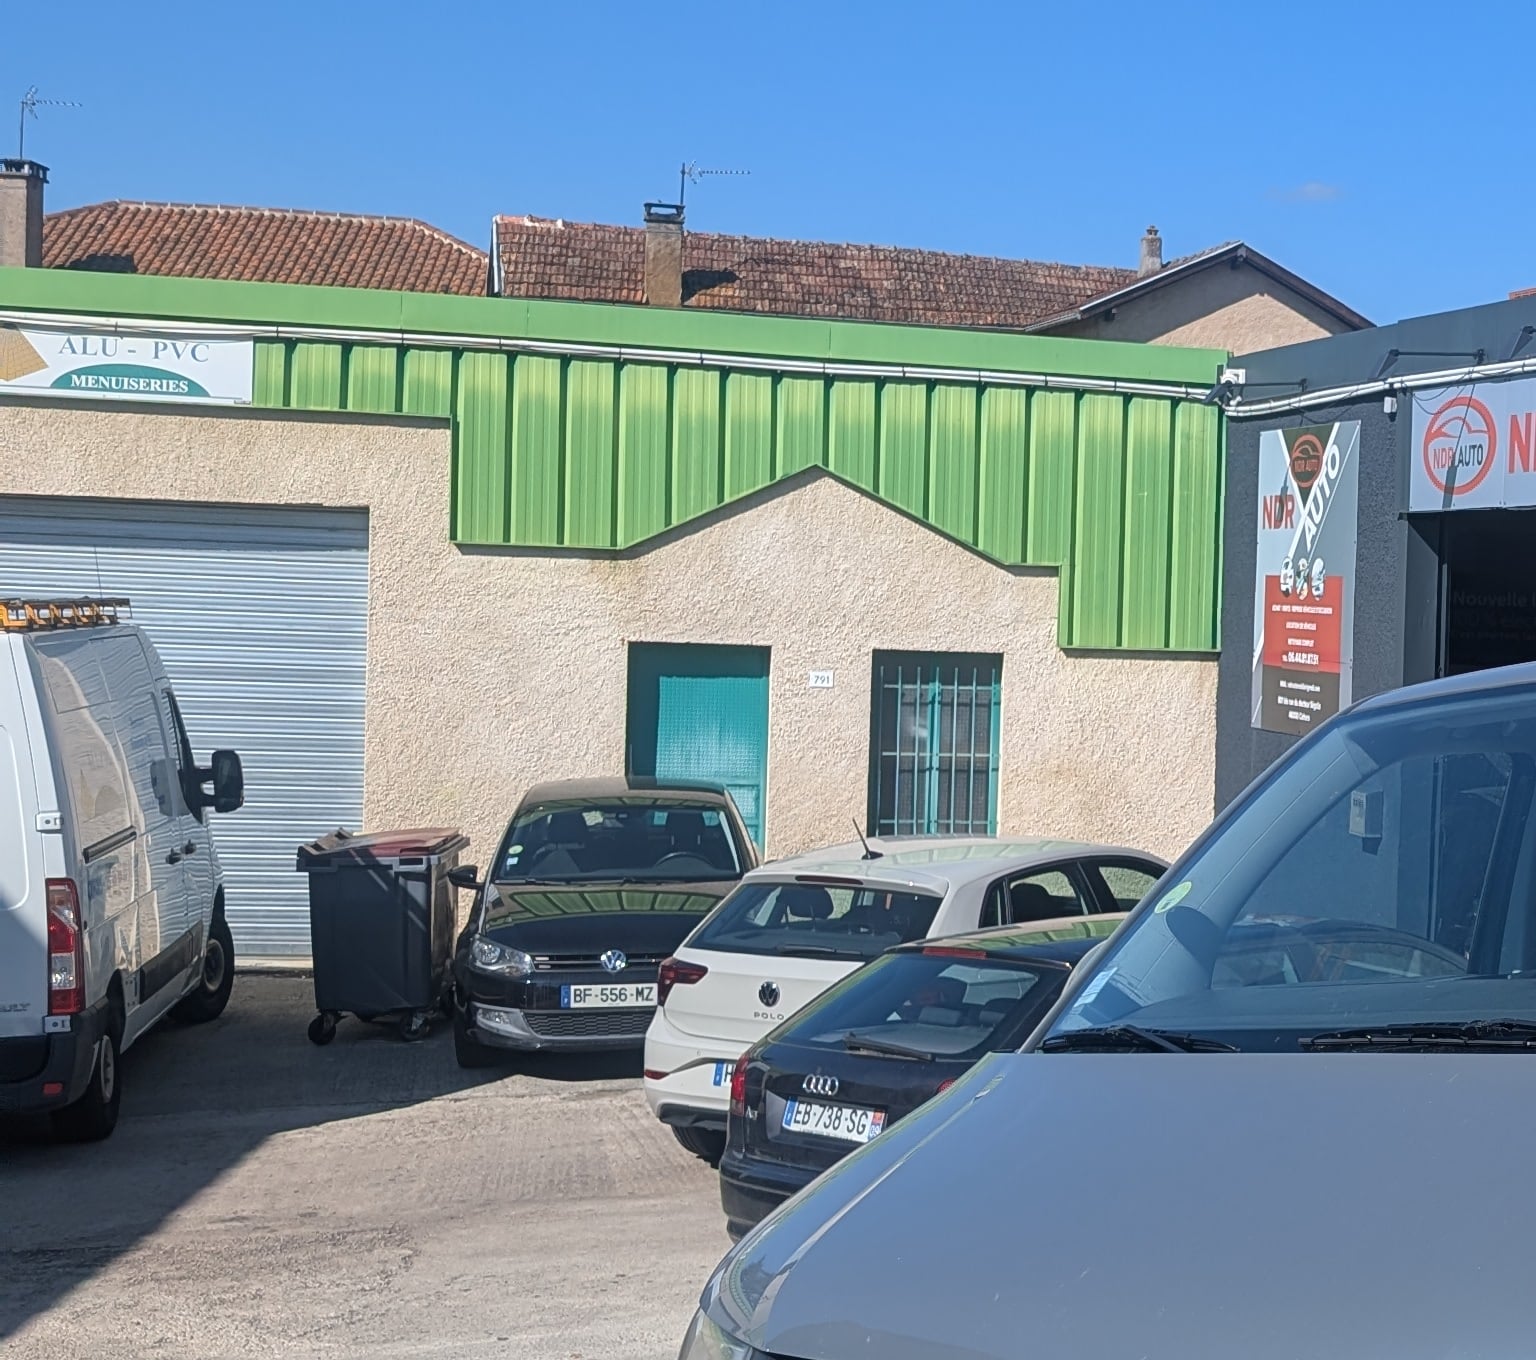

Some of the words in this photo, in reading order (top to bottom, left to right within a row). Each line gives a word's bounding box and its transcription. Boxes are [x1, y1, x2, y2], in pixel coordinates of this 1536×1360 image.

[59, 337, 118, 357] ALU
[152, 341, 210, 362] PVC
[71, 374, 188, 393] MENUISERIES
[1454, 440, 1484, 466] AUTO
[1304, 444, 1340, 553] AUTO
[1262, 494, 1295, 530] NDR
[1453, 591, 1527, 608] Nouvelle
[814, 675, 830, 685] 791
[573, 986, 654, 1003] BF-556-MZ
[753, 1011, 785, 1020] POLO
[793, 1103, 868, 1136] EB-738-SG
